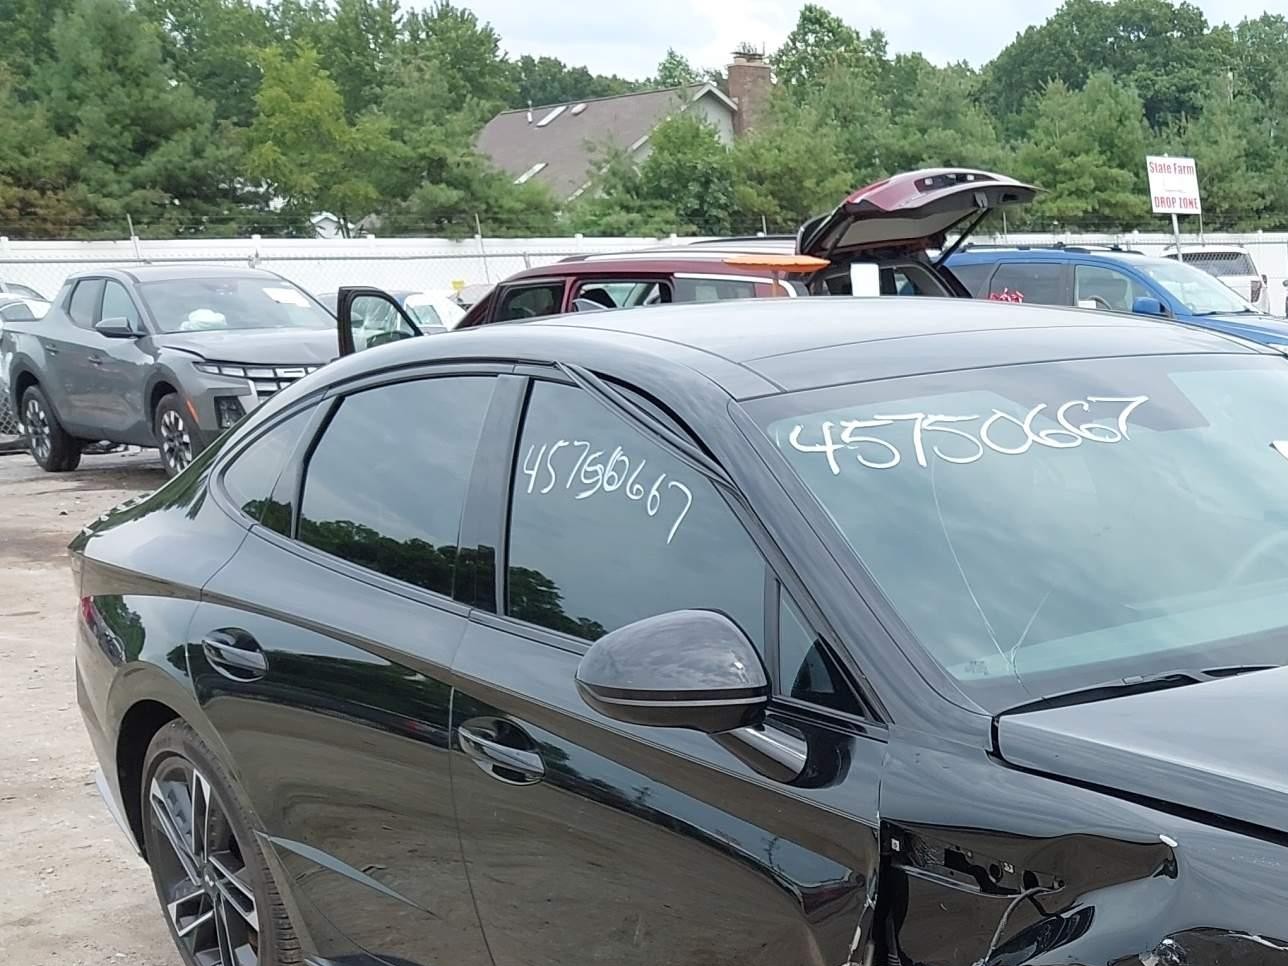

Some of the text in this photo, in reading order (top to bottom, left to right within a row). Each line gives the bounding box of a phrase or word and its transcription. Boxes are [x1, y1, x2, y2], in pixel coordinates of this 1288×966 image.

[1149, 161, 1195, 176] State Farm
[1154, 196, 1199, 210] DROP ZONE
[788, 395, 1150, 476] 45750667
